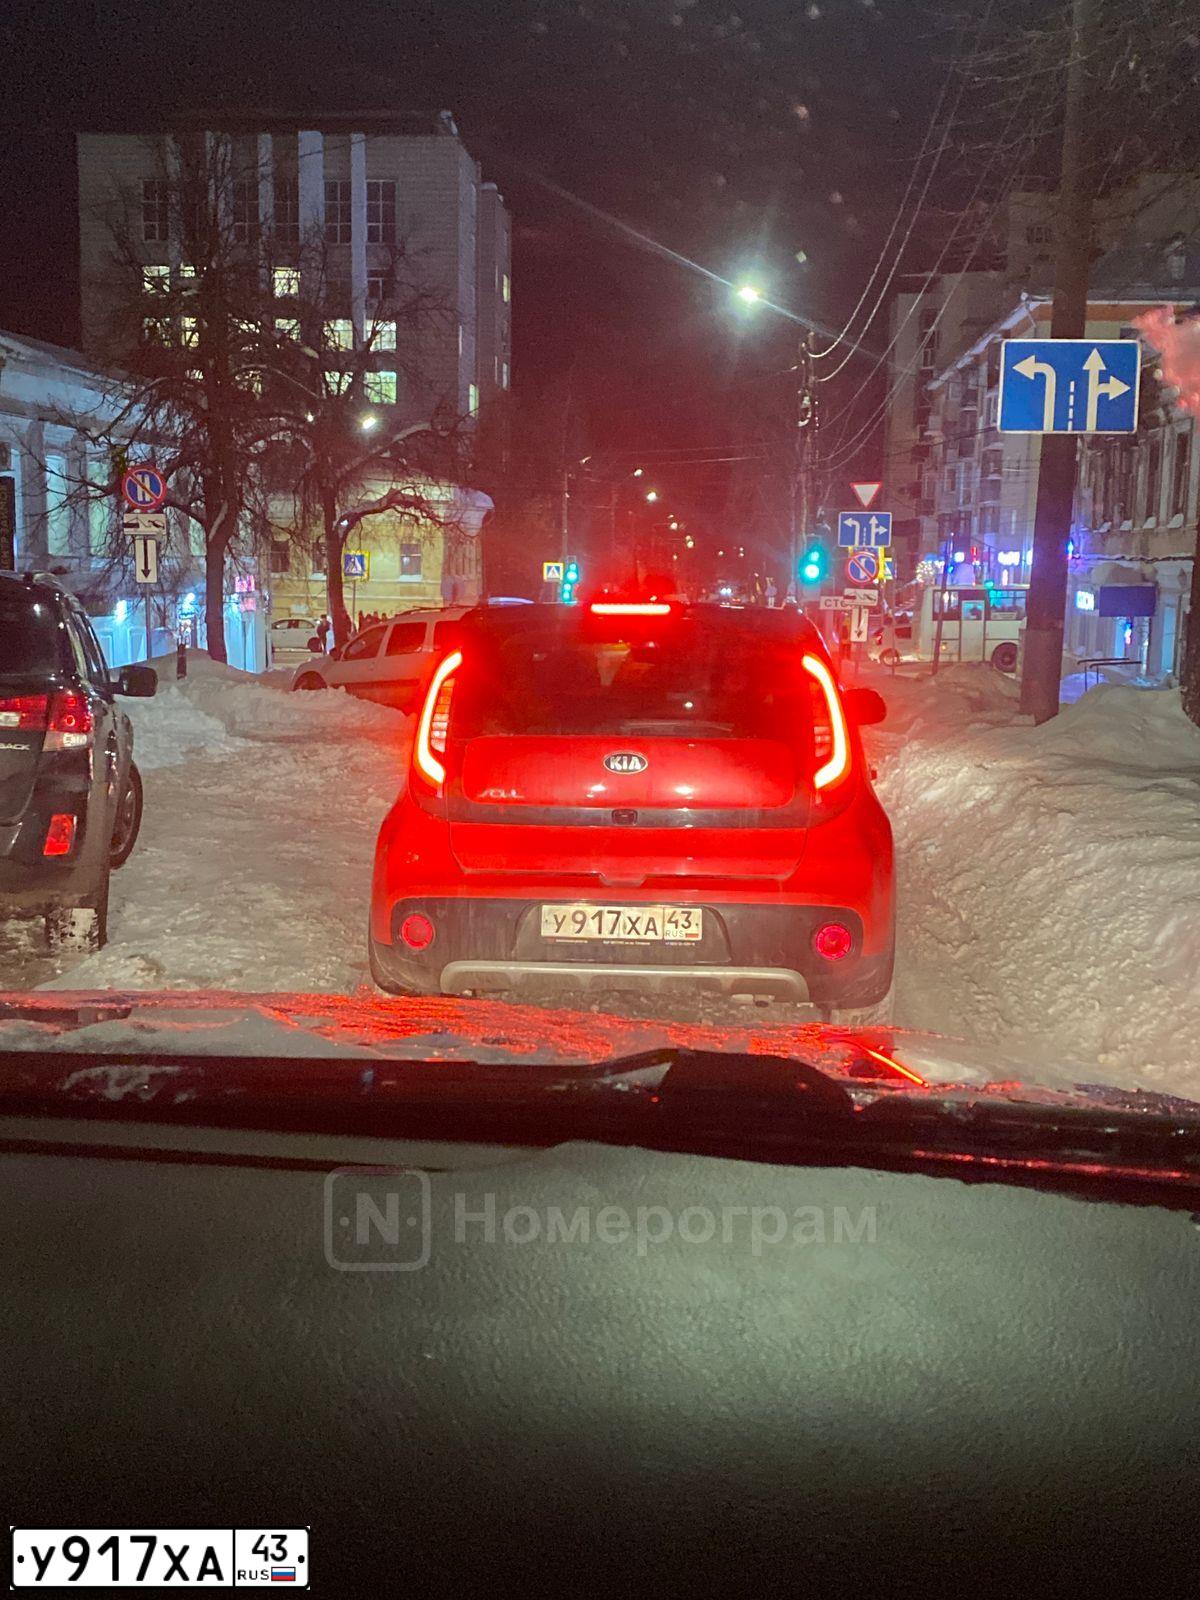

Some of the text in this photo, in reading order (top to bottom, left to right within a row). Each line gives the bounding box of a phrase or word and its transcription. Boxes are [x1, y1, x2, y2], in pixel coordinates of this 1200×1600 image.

[824, 598, 849, 608] СТО
[609, 755, 642, 771] KIA
[553, 909, 693, 936] У917ХА 43
[665, 929, 684, 938] RUS
